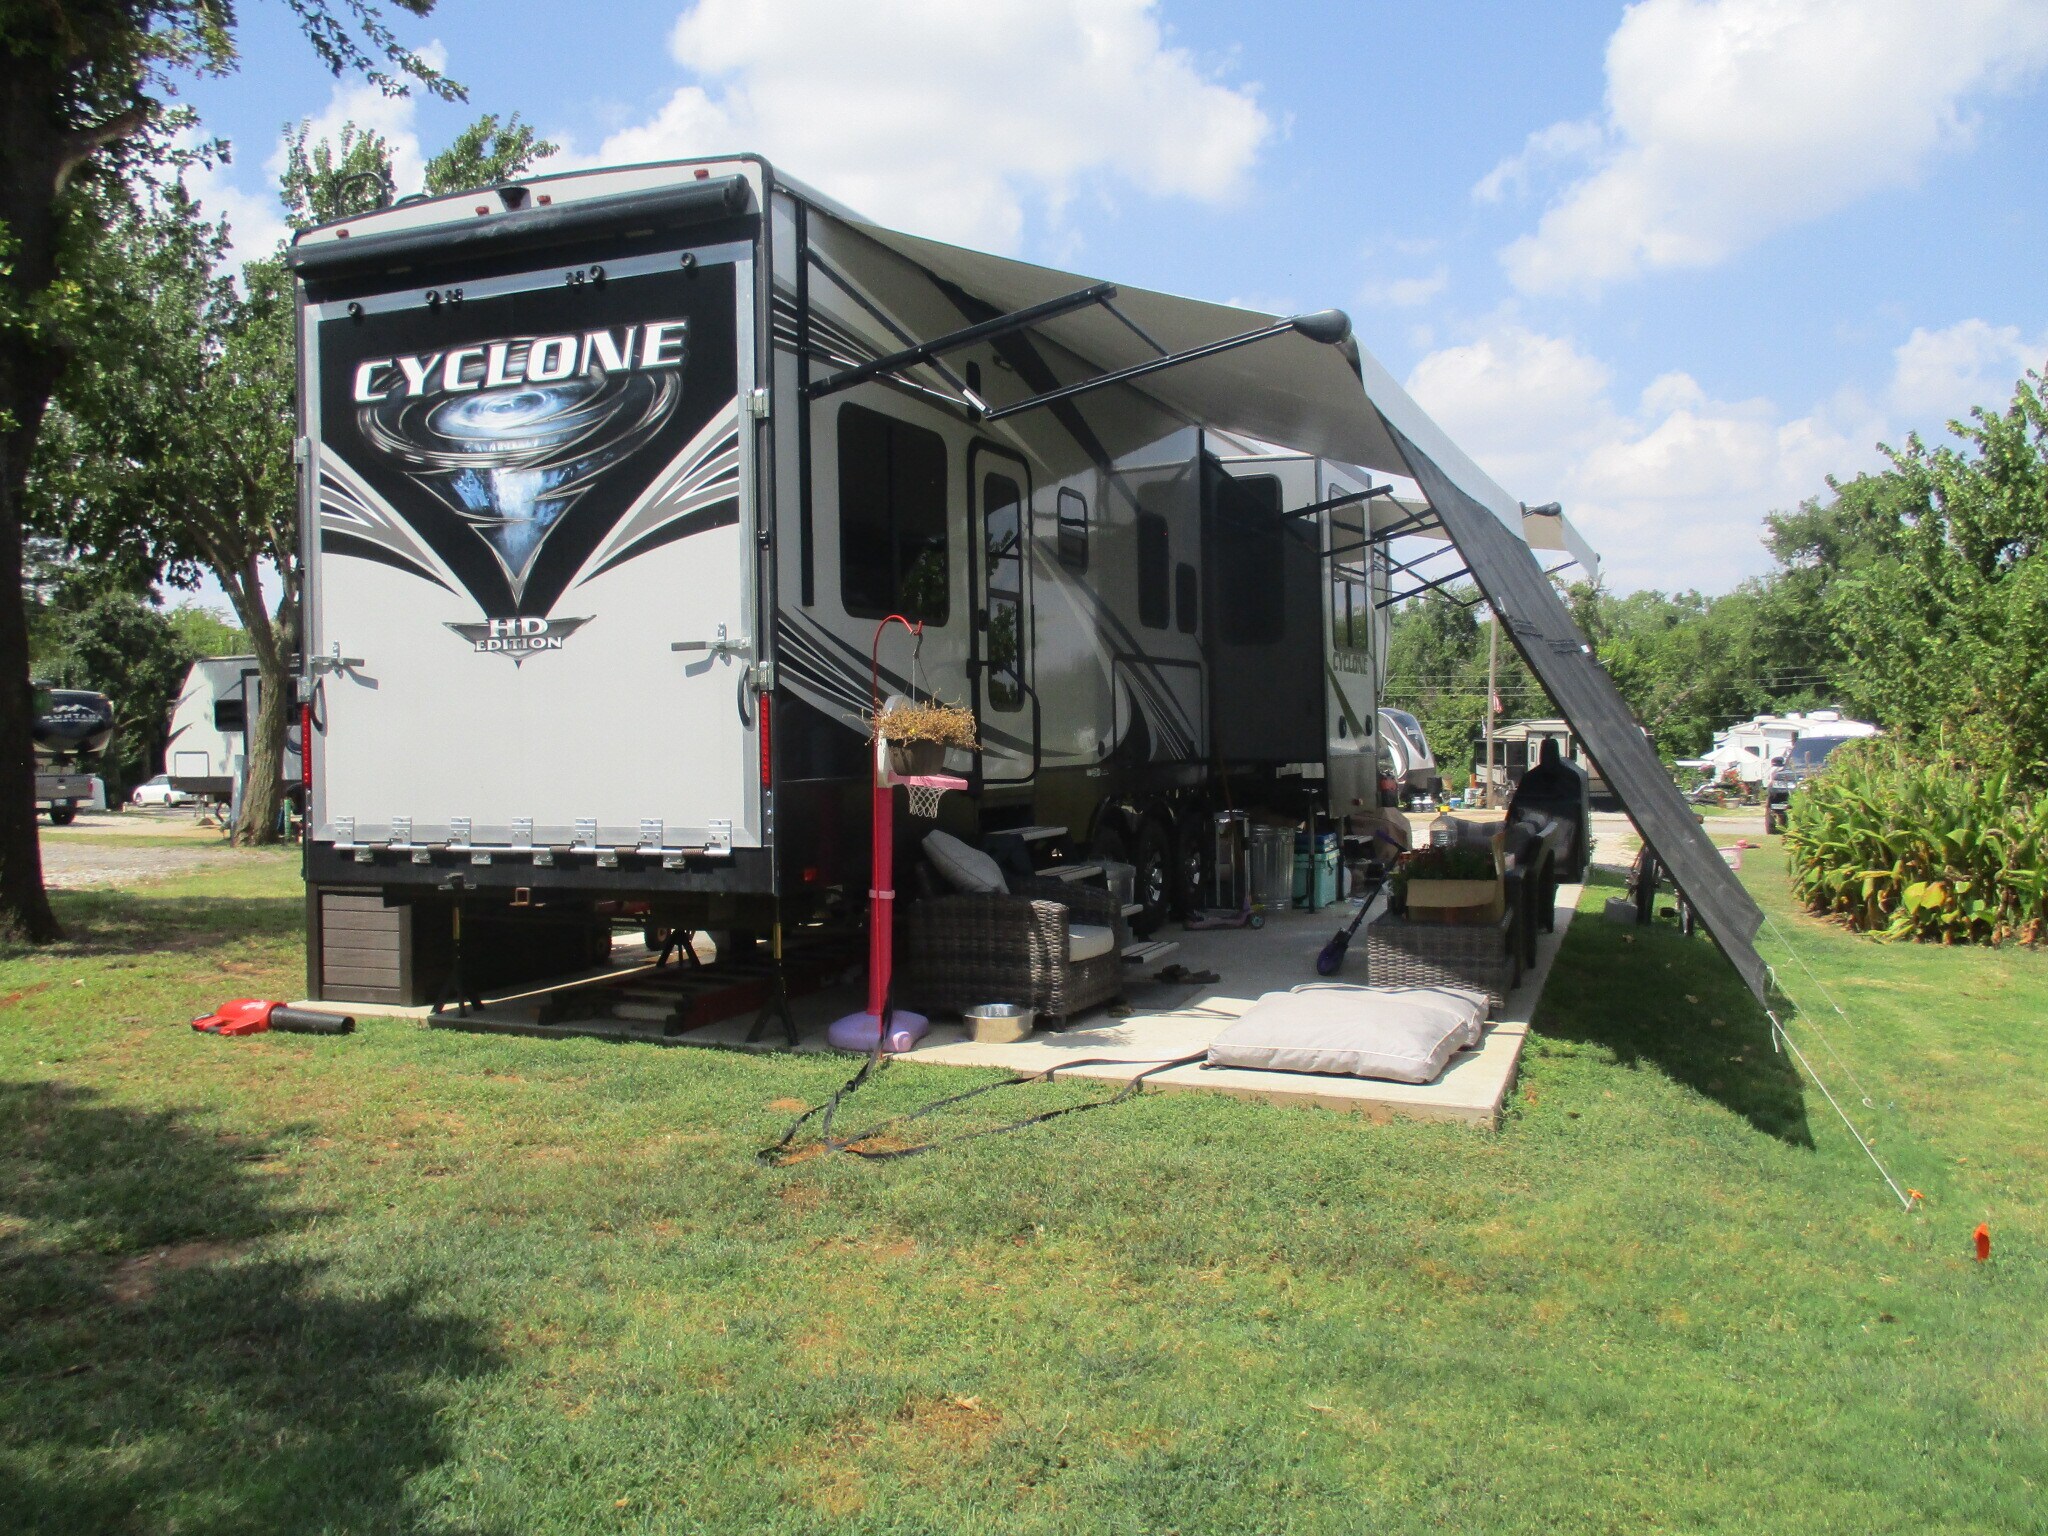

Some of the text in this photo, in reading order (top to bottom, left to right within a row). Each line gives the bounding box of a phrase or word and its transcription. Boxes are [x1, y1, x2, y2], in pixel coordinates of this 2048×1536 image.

[353, 319, 687, 402] CYCLONE
[489, 616, 549, 638] HD
[475, 636, 563, 652] EDITION
